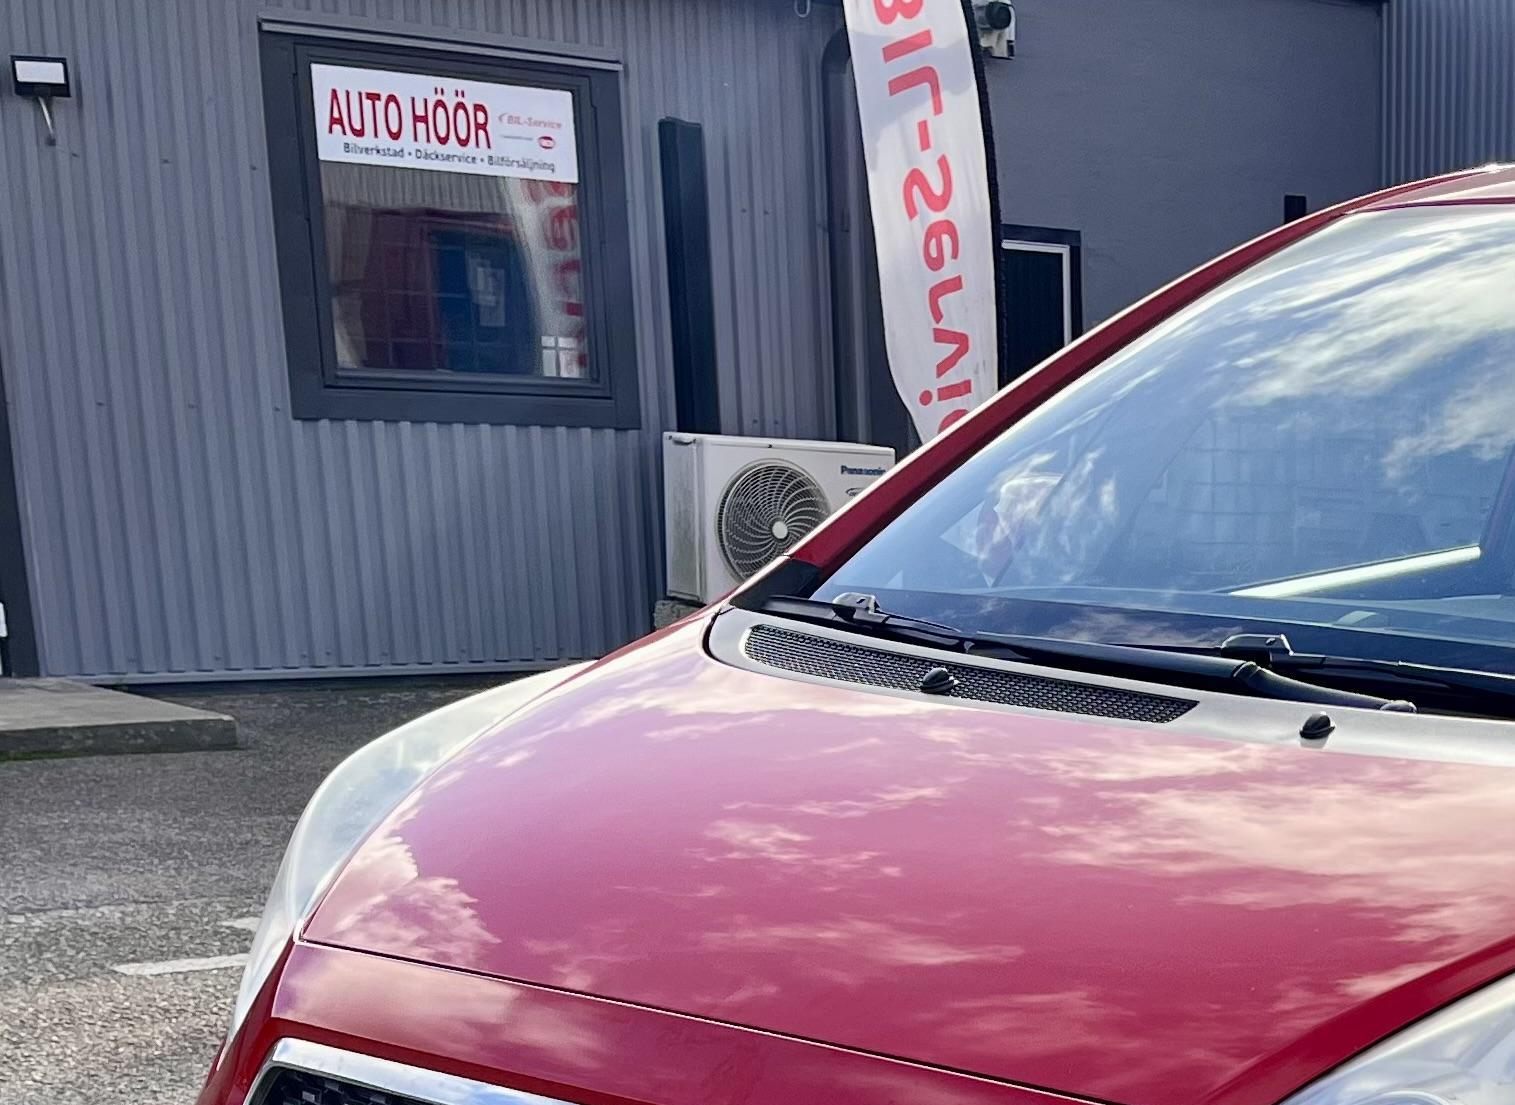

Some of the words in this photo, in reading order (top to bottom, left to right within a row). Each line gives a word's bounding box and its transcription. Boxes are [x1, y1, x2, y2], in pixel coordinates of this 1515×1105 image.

[328, 88, 403, 141] AUTO
[410, 87, 492, 149] HÖÖR
[343, 142, 404, 158] Bilverkstad
[415, 148, 477, 164] Däckservice
[487, 155, 556, 174] Bilförsäljning
